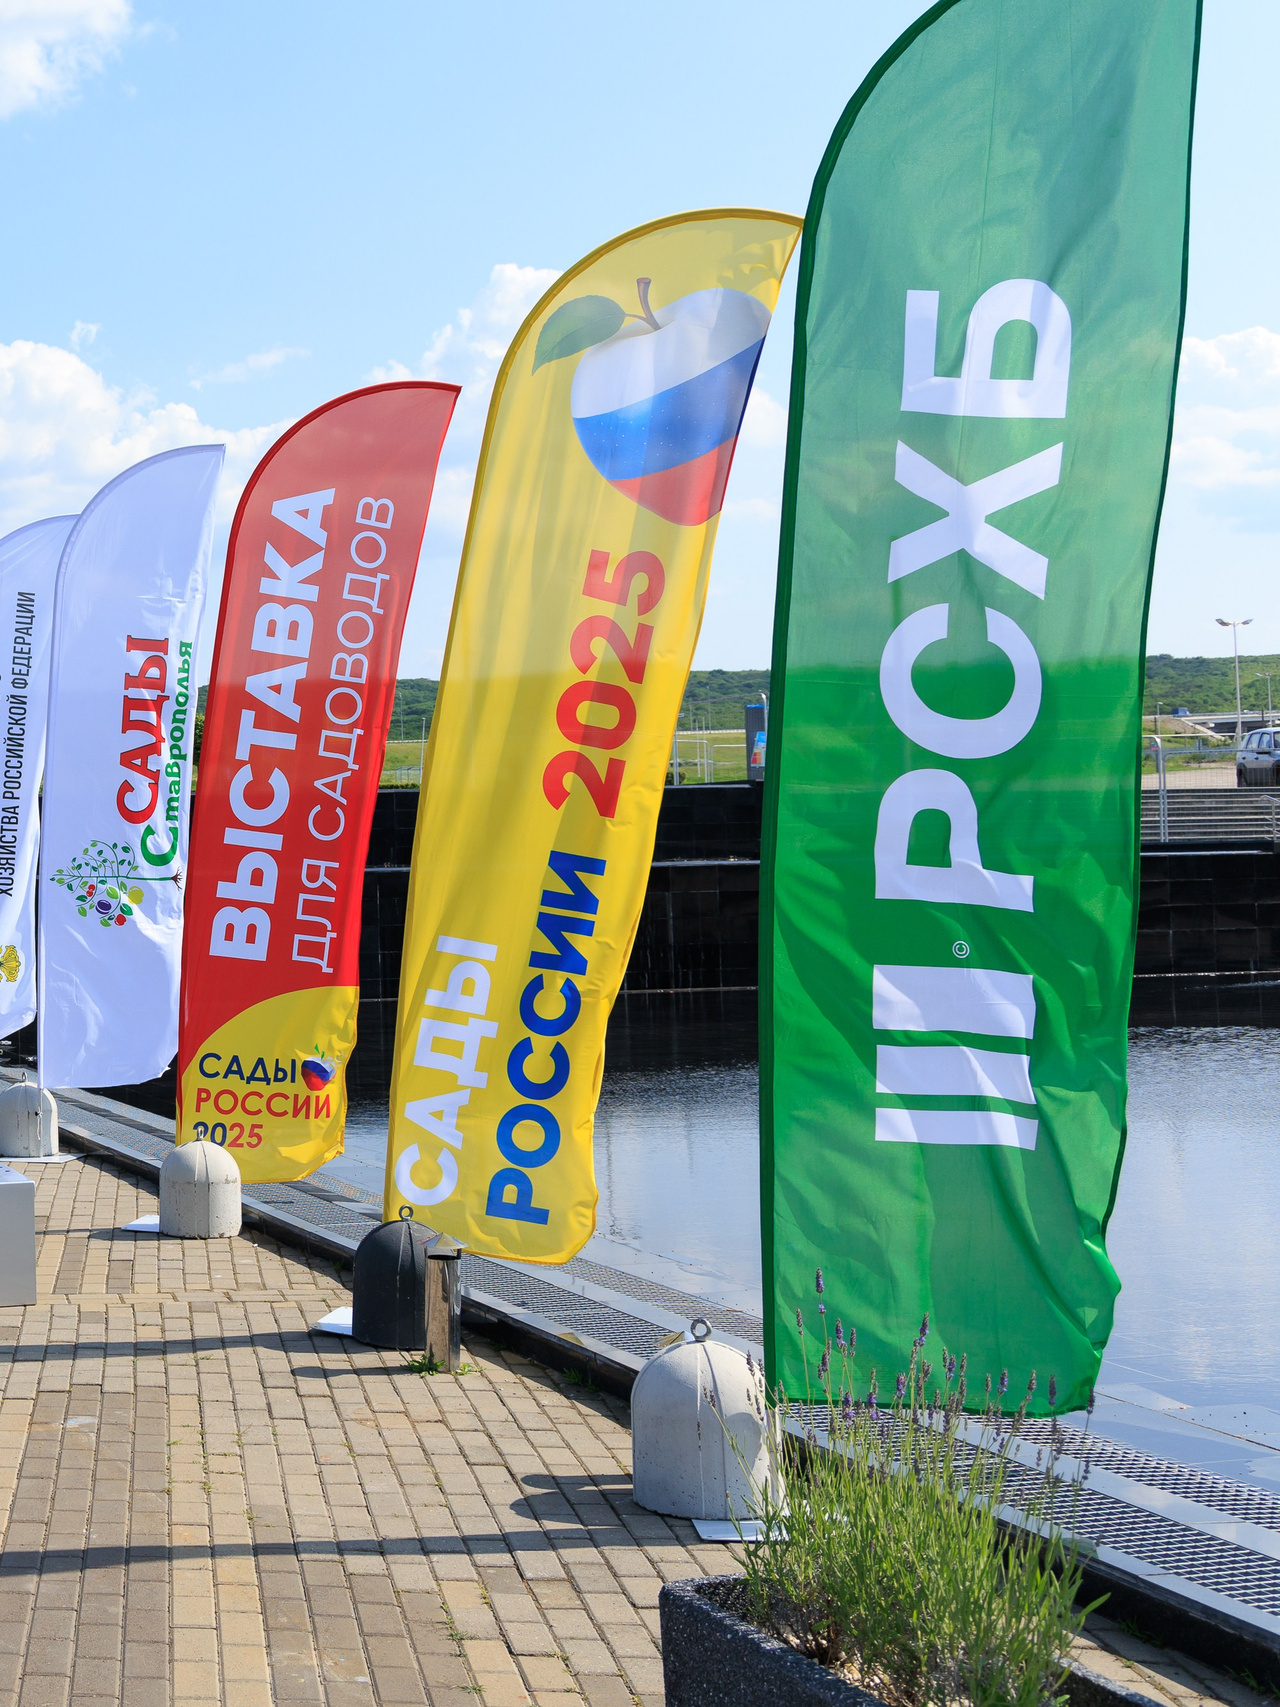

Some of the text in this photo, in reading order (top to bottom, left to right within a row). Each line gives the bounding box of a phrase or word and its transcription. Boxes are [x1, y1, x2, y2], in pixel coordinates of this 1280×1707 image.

[11, 591, 36, 689] ФЕДЕРАЦИИ
[874, 277, 1072, 914] РСХБ
[3, 694, 28, 800] РОССИЙСКОЙ
[116, 634, 170, 825] САДЫ
[140, 640, 193, 867] Ставрополья
[209, 487, 335, 962] ВЫСТАВКА
[292, 496, 395, 973] ДЛЯ САДОВОДОВ
[485, 549, 667, 1226] РОССИИ 2025
[195, 1087, 331, 1120] РОССИИ
[198, 1052, 297, 1086] САДЫ
[394, 935, 499, 1206] САДЫ
